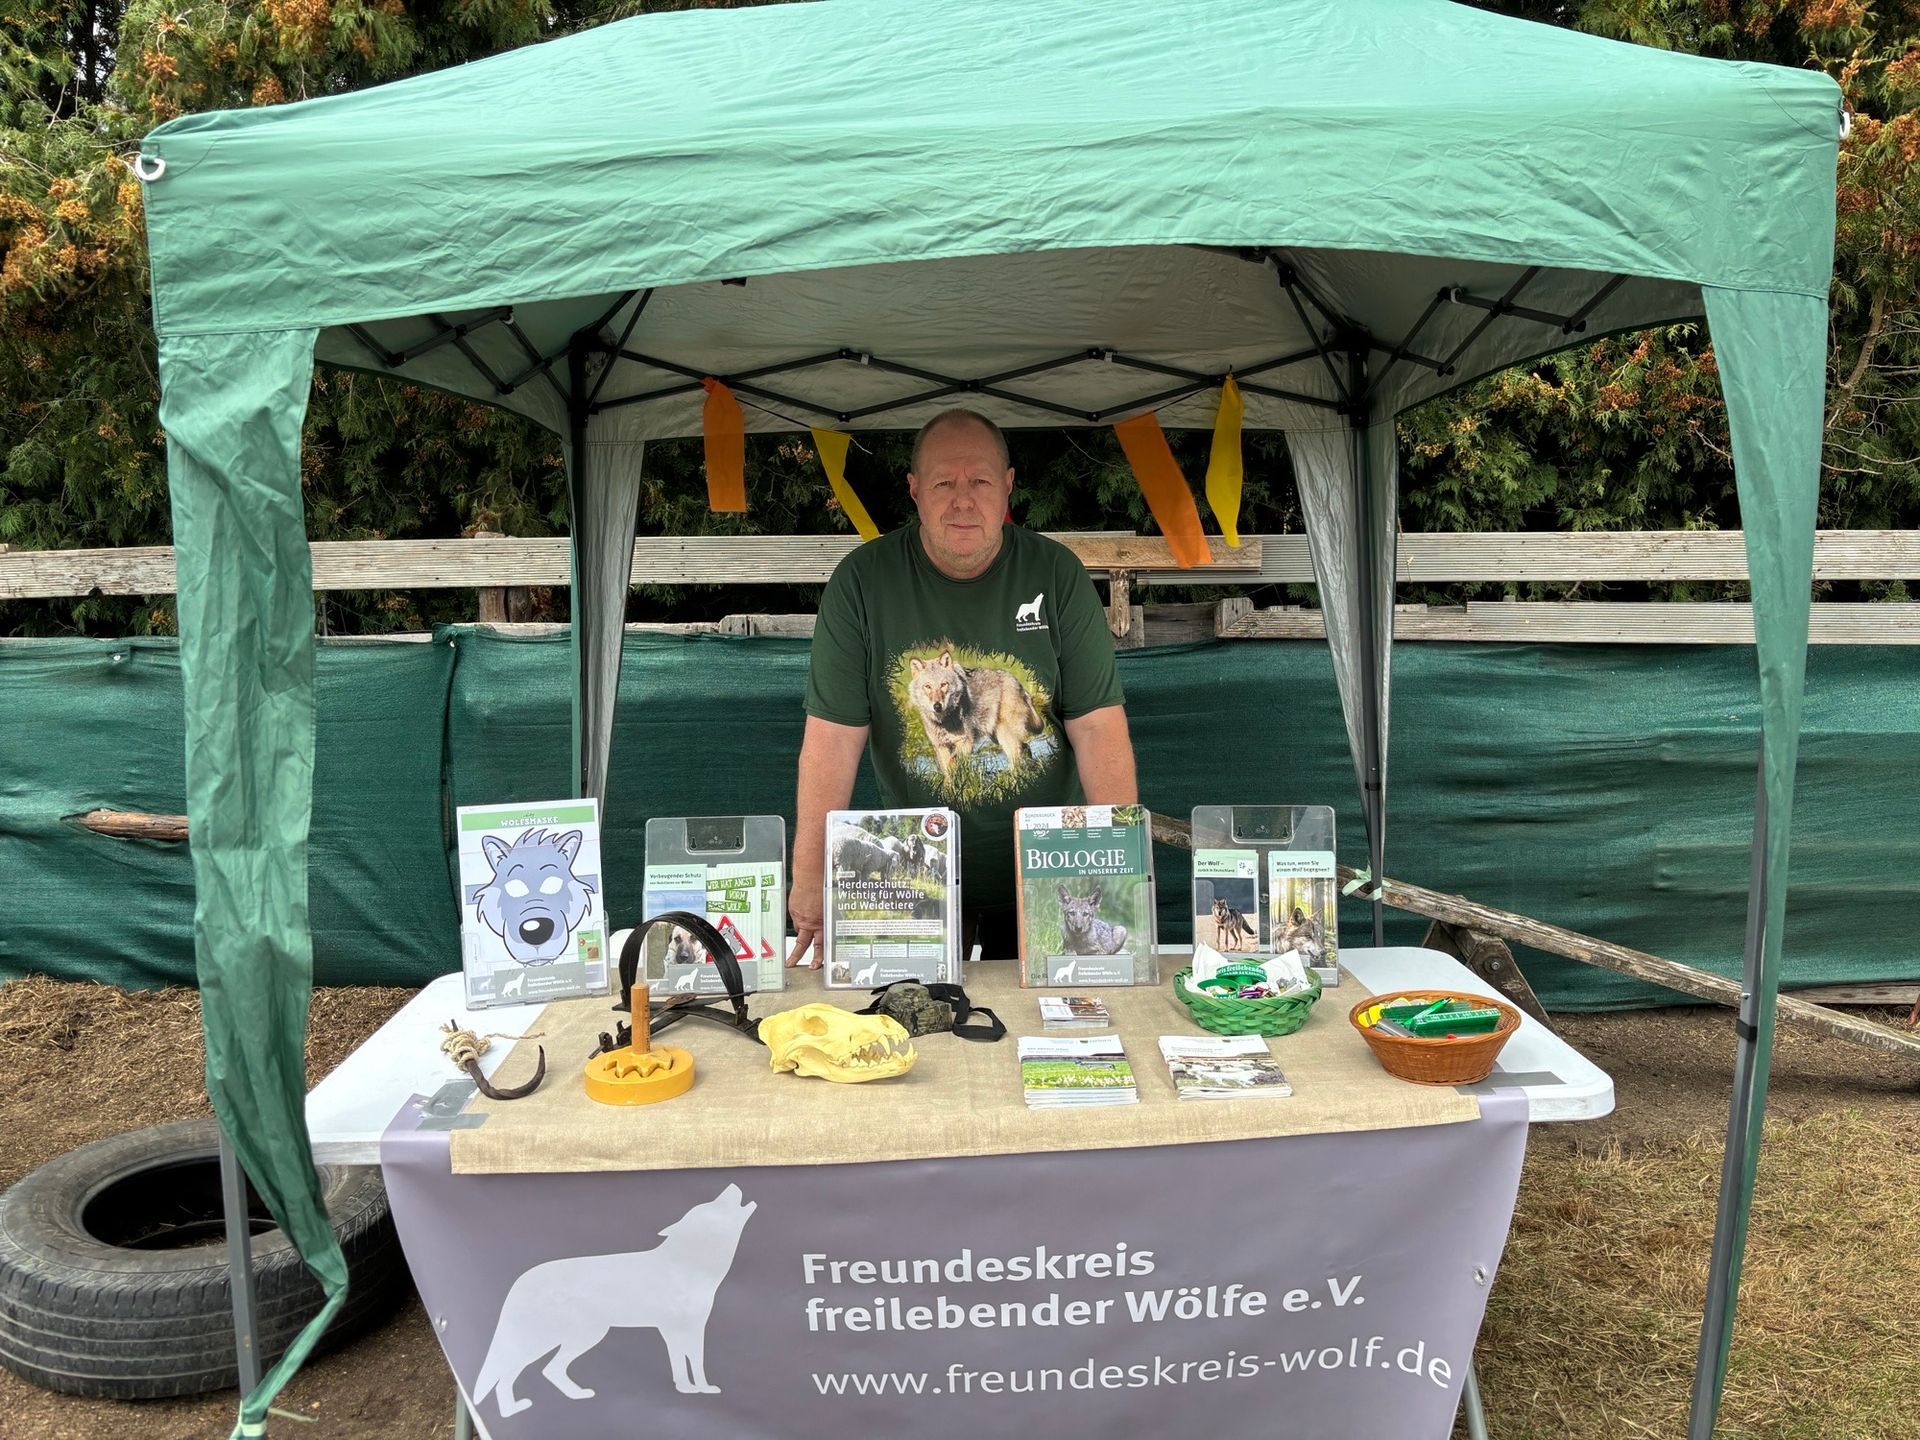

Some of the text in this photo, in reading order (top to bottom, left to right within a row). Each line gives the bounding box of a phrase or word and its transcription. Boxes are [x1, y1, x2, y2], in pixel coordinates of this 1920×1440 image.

[500, 816, 558, 826] WOLFSMASKE
[708, 876, 754, 889] WER HAT ANGST
[729, 890, 746, 900] VORM
[838, 890, 924, 901] Wichtig für Wölfe
[726, 902, 740, 911] WOLF
[838, 900, 914, 910] und Weidetiere
[802, 1242, 1155, 1284] Freundeskreis
[805, 1275, 1366, 1331] freilebender Wölfe e.V.
[812, 1336, 1452, 1394] www.freundeskreis-wolf.de
